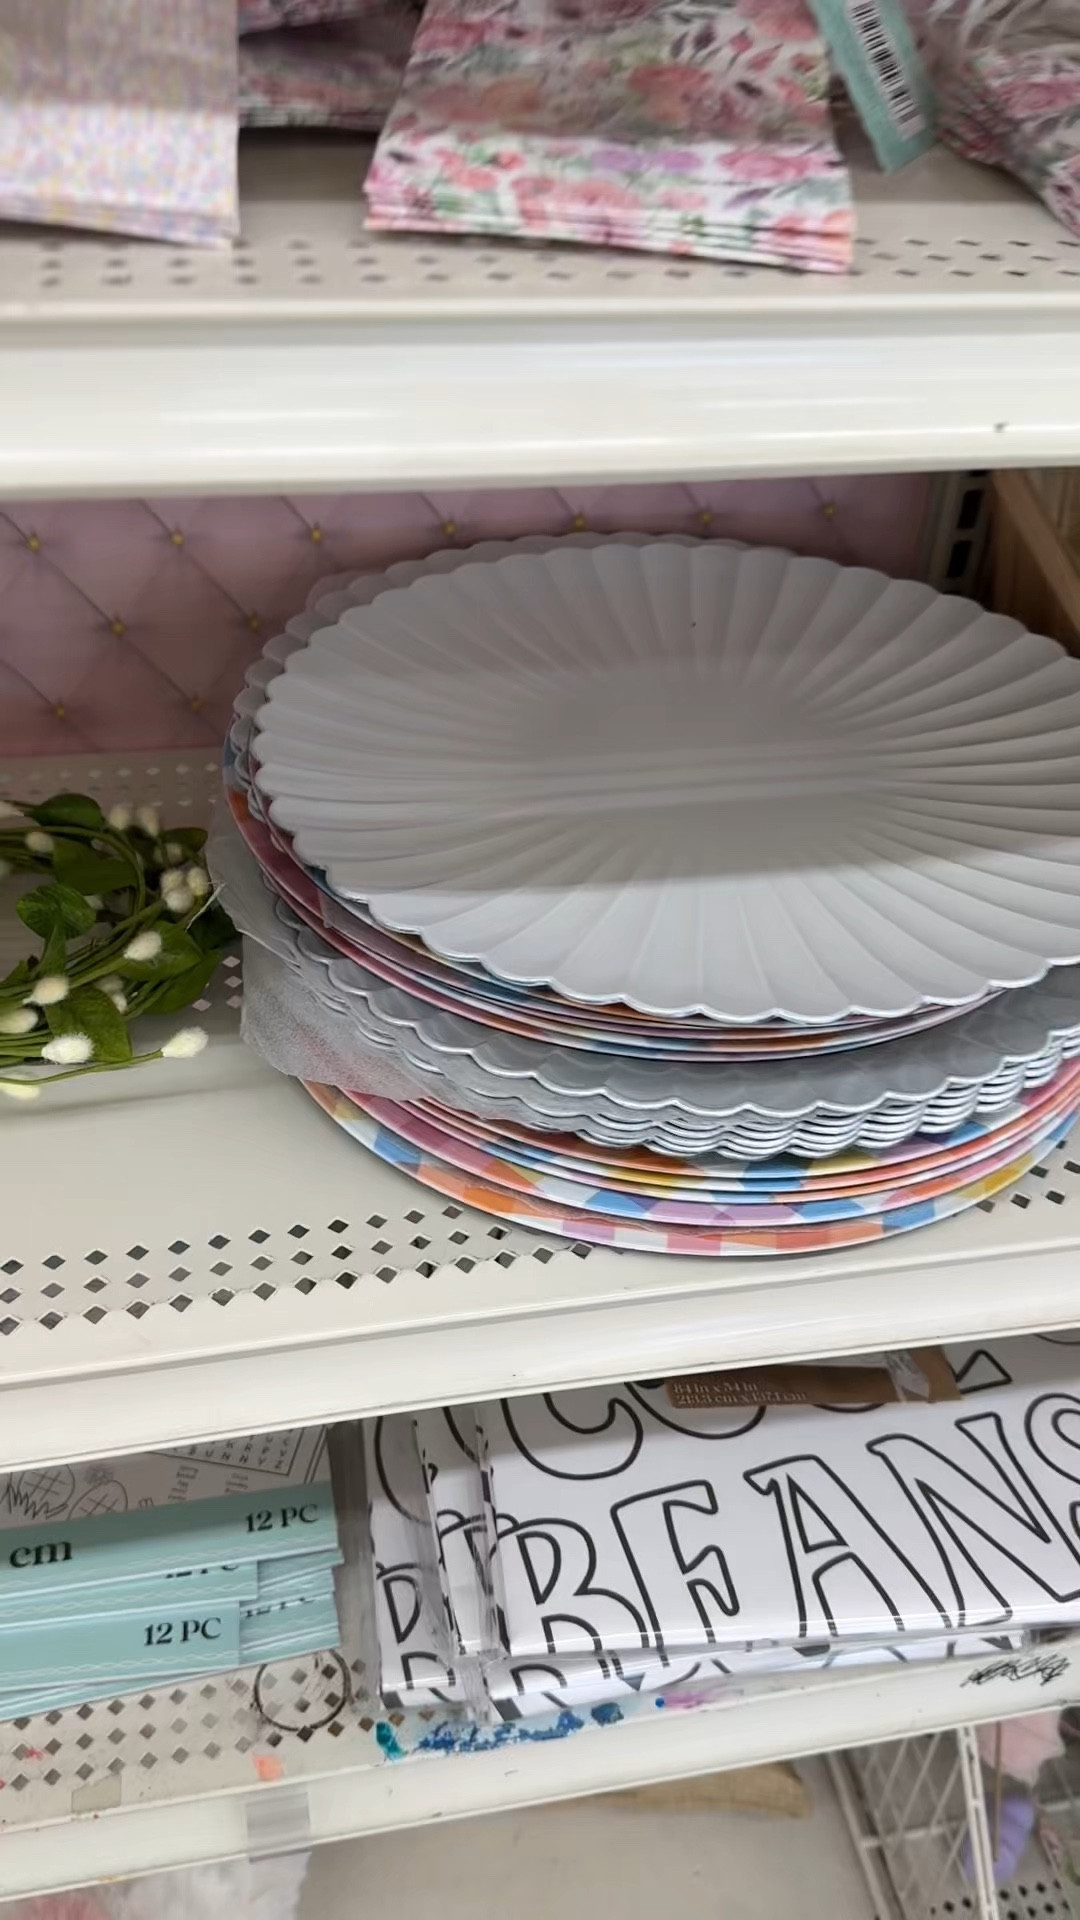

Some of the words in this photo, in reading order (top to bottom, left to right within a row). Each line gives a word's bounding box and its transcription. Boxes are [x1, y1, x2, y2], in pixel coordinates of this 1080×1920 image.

[245, 1511, 273, 1533] 12
[280, 1503, 319, 1528] PC
[9, 1541, 73, 1568] cm
[144, 1622, 173, 1646] 12
[180, 1617, 222, 1642] PC
